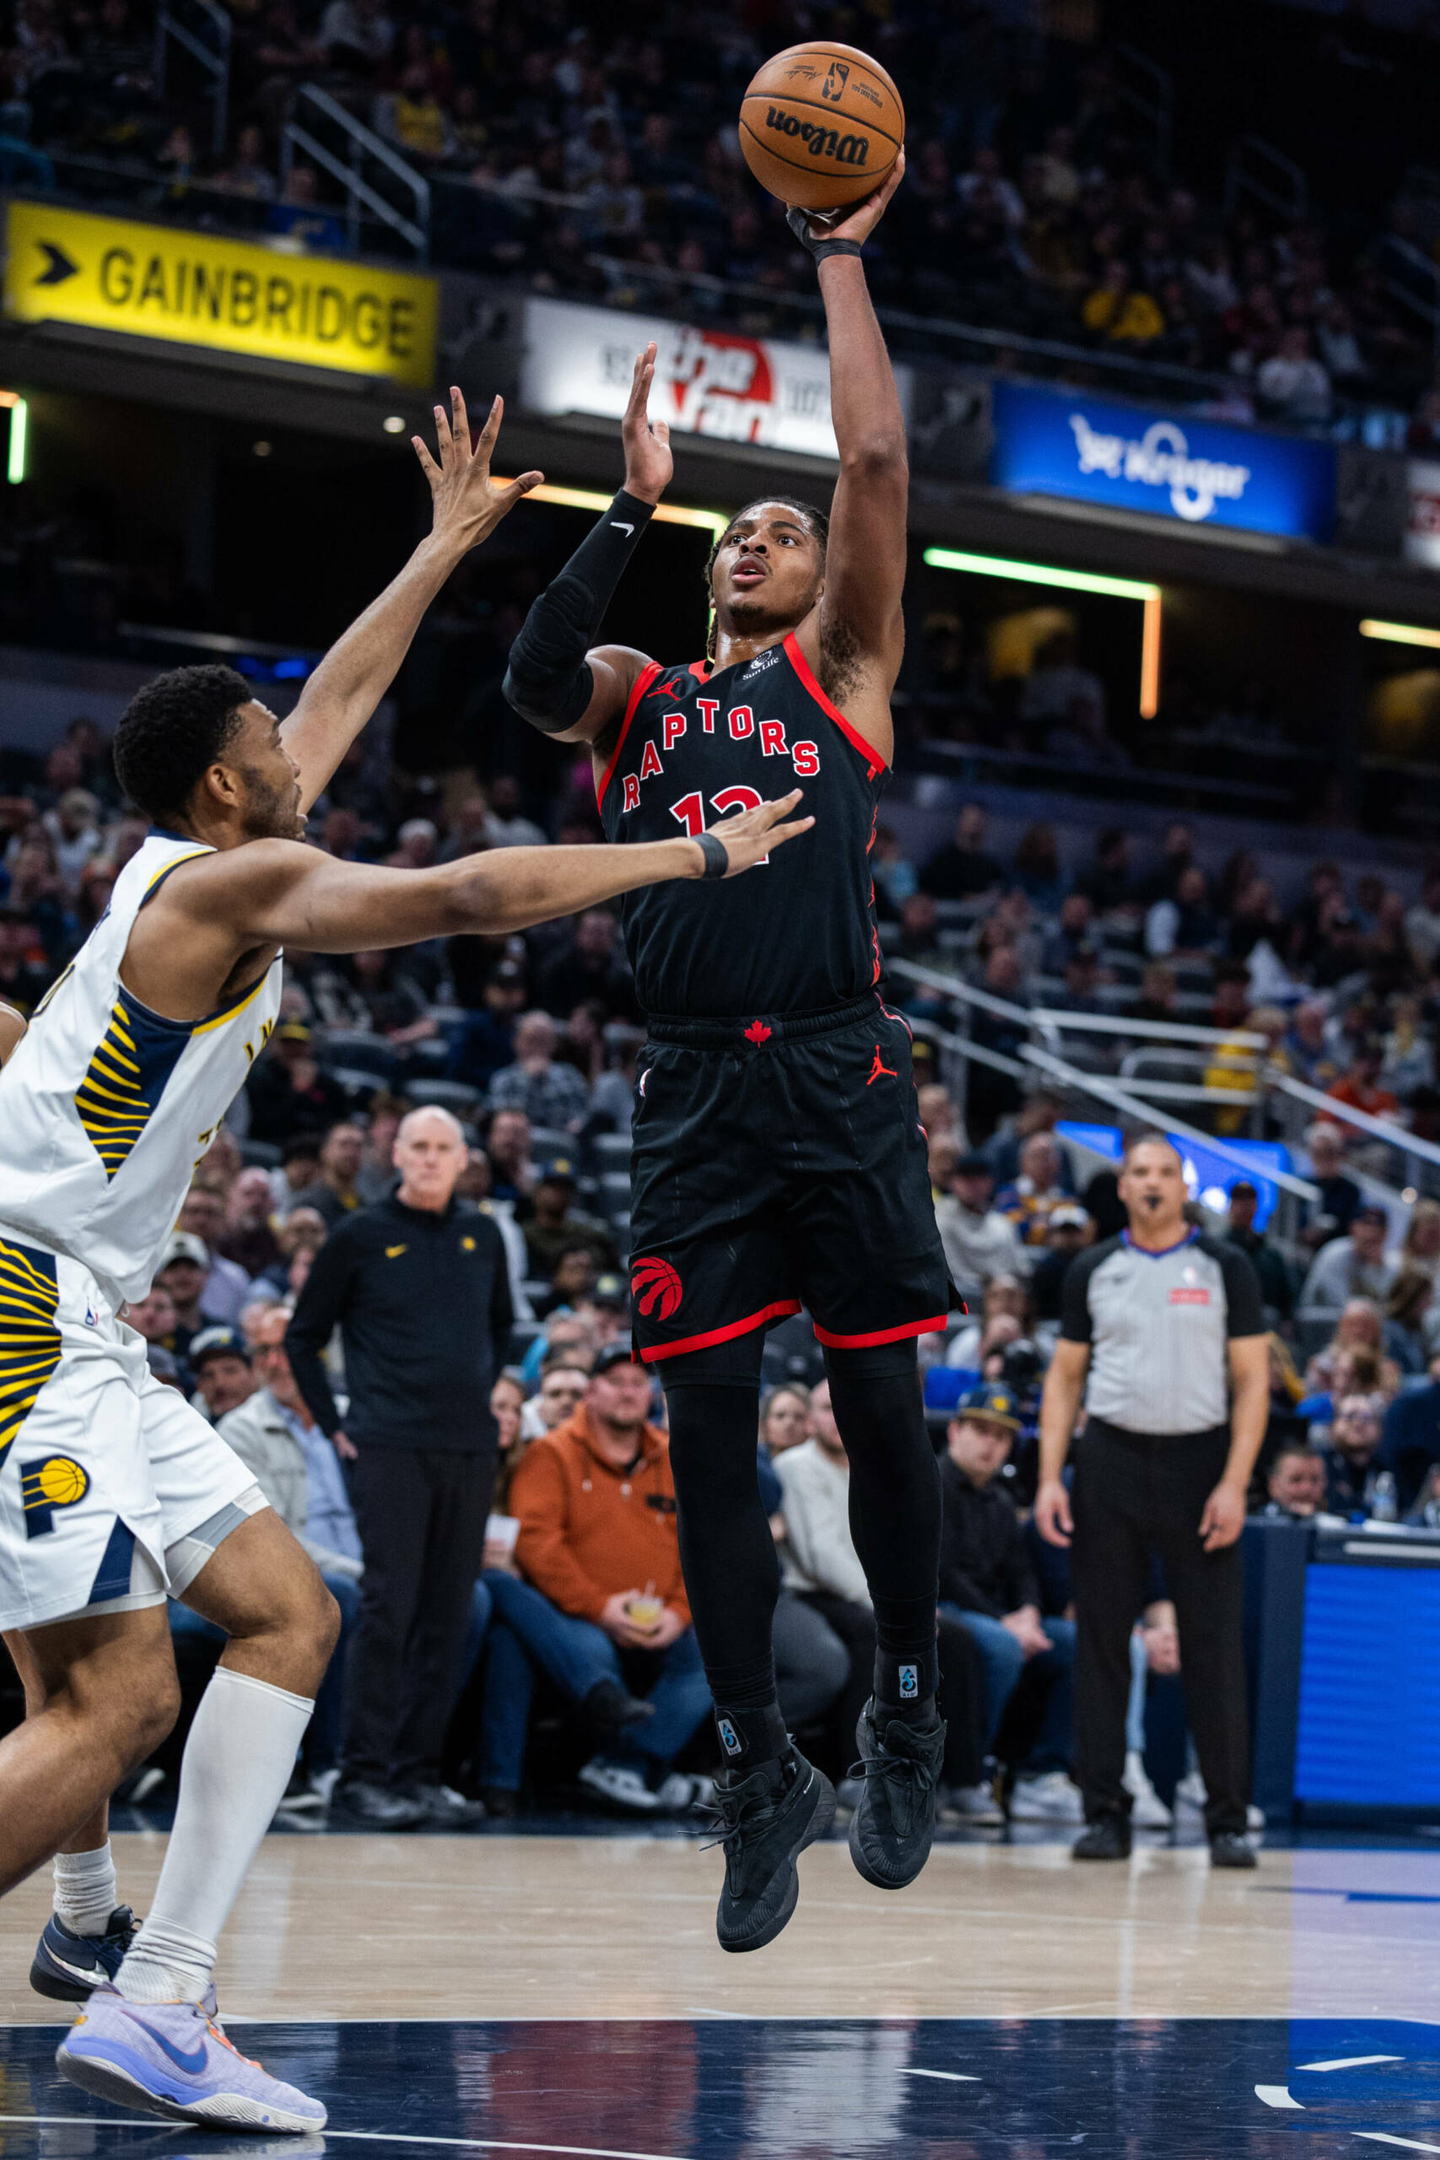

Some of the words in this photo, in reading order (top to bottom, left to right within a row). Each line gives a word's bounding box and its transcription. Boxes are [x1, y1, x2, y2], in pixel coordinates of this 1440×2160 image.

[766, 106, 869, 166] Wilson
[100, 245, 415, 357] GAINBRIDGE
[742, 668, 761, 681] Sun
[762, 656, 780, 671] Life
[622, 697, 821, 814] RAPTORS
